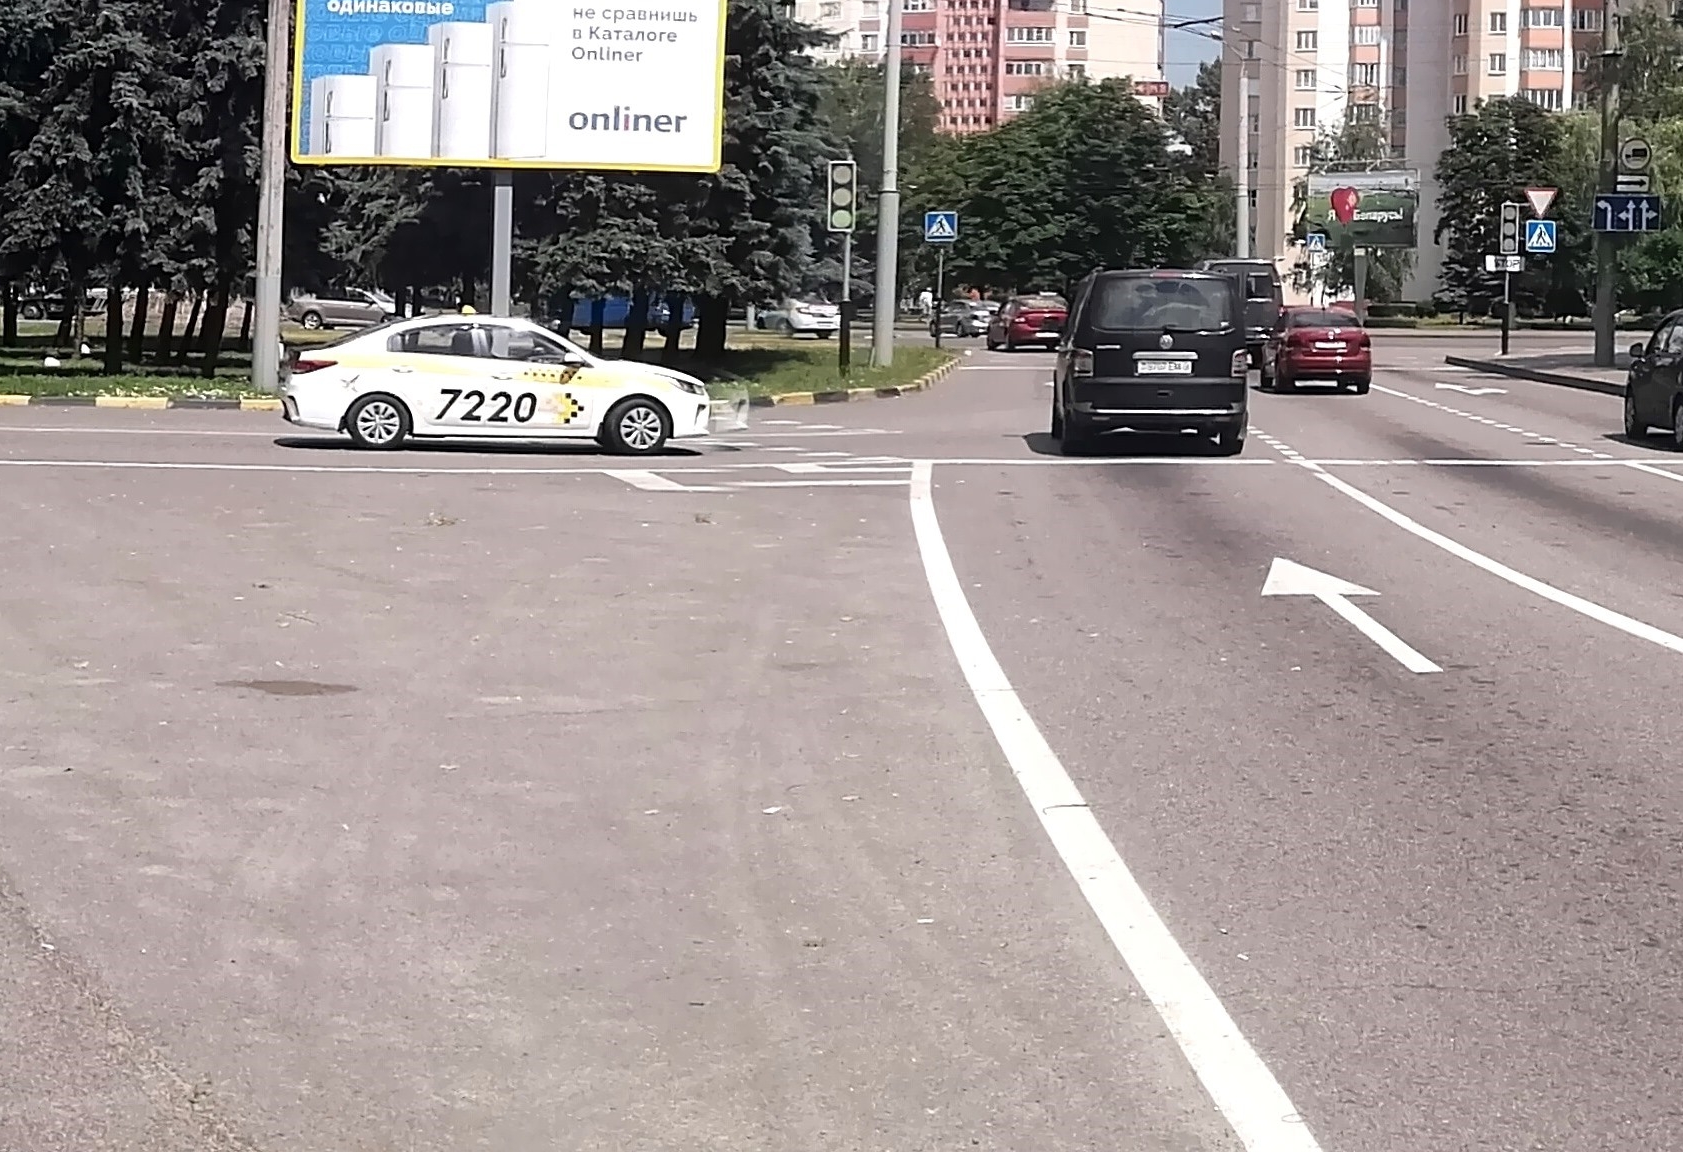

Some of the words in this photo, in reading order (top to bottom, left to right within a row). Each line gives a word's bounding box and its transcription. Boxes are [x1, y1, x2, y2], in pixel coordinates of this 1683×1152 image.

[327, 0, 454, 16] одинаковые
[572, 7, 596, 20] не
[601, 8, 698, 24] сравнишь
[572, 28, 582, 40] в
[588, 25, 678, 43] Каталоге
[571, 46, 644, 62] Onliner
[568, 105, 688, 134] onliner
[1327, 209, 1337, 221] Я
[434, 388, 538, 423] 7220
